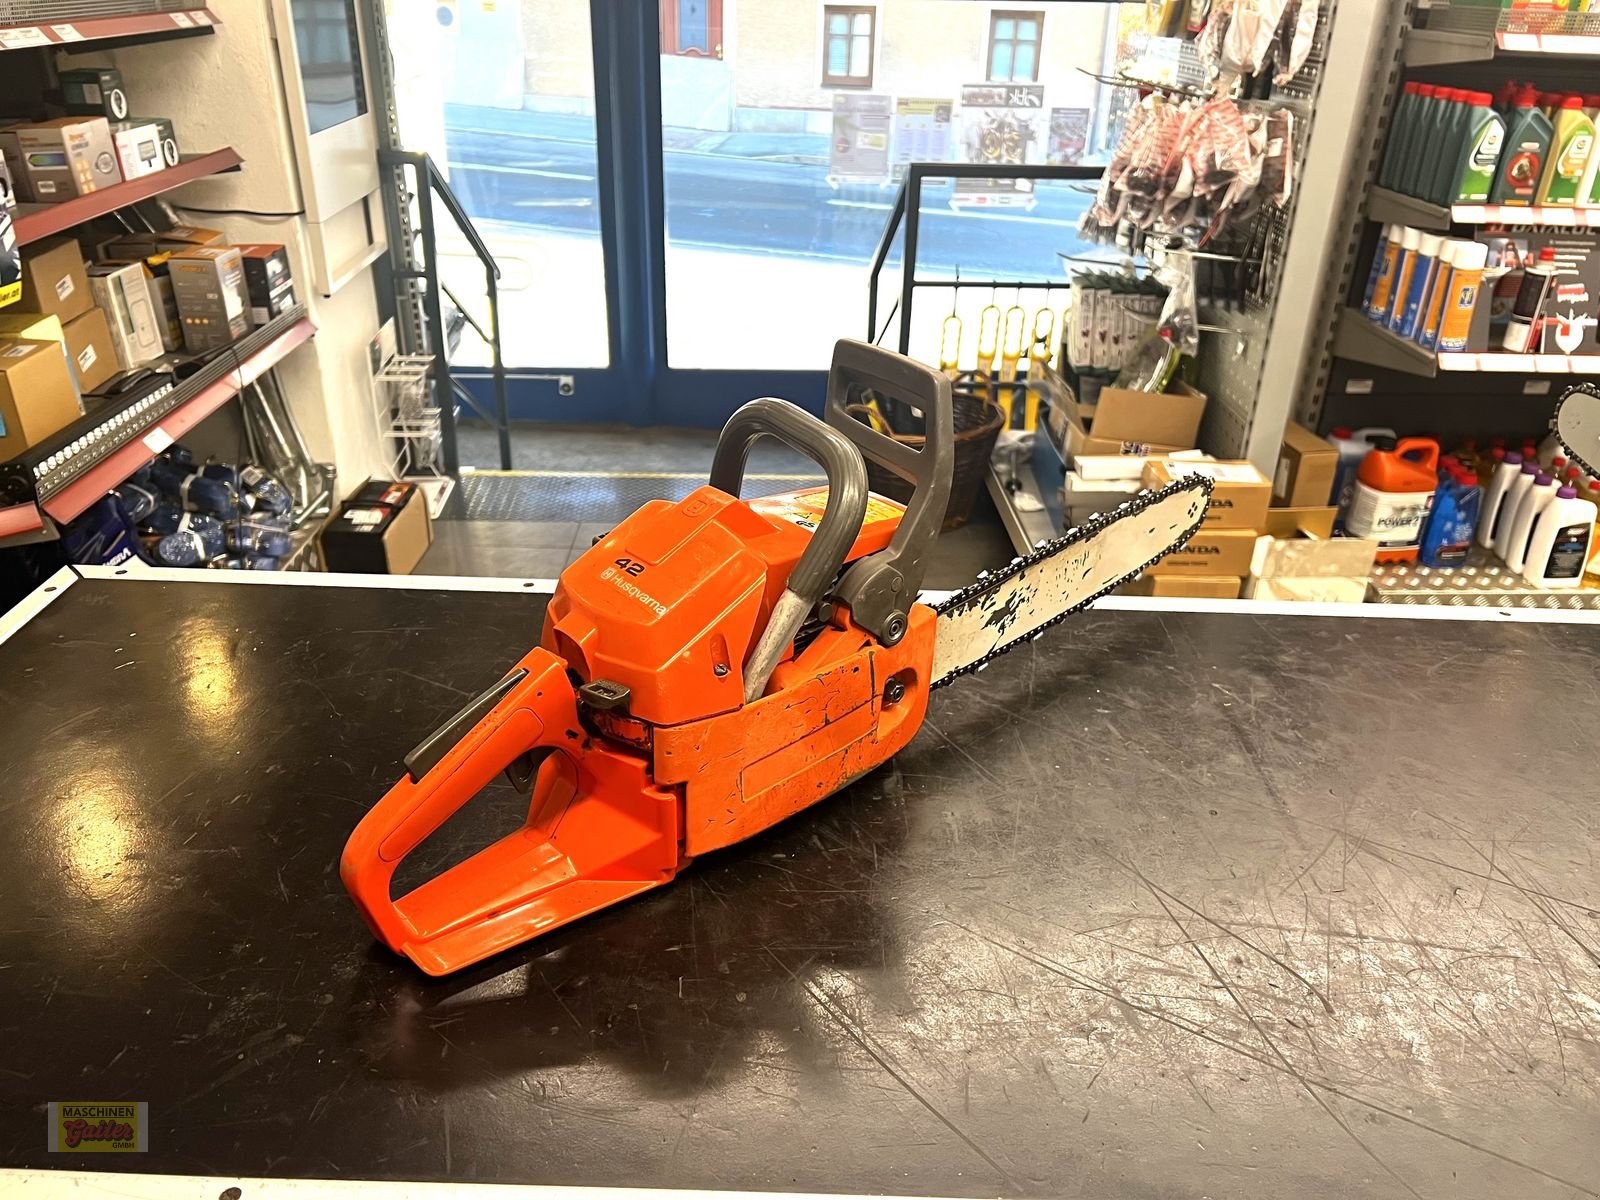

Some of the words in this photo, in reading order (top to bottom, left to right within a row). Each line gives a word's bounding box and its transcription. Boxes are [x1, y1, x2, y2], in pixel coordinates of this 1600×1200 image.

[1377, 516, 1412, 527] POWER
[614, 558, 645, 577] 42
[609, 573, 667, 615] Husqvarna
